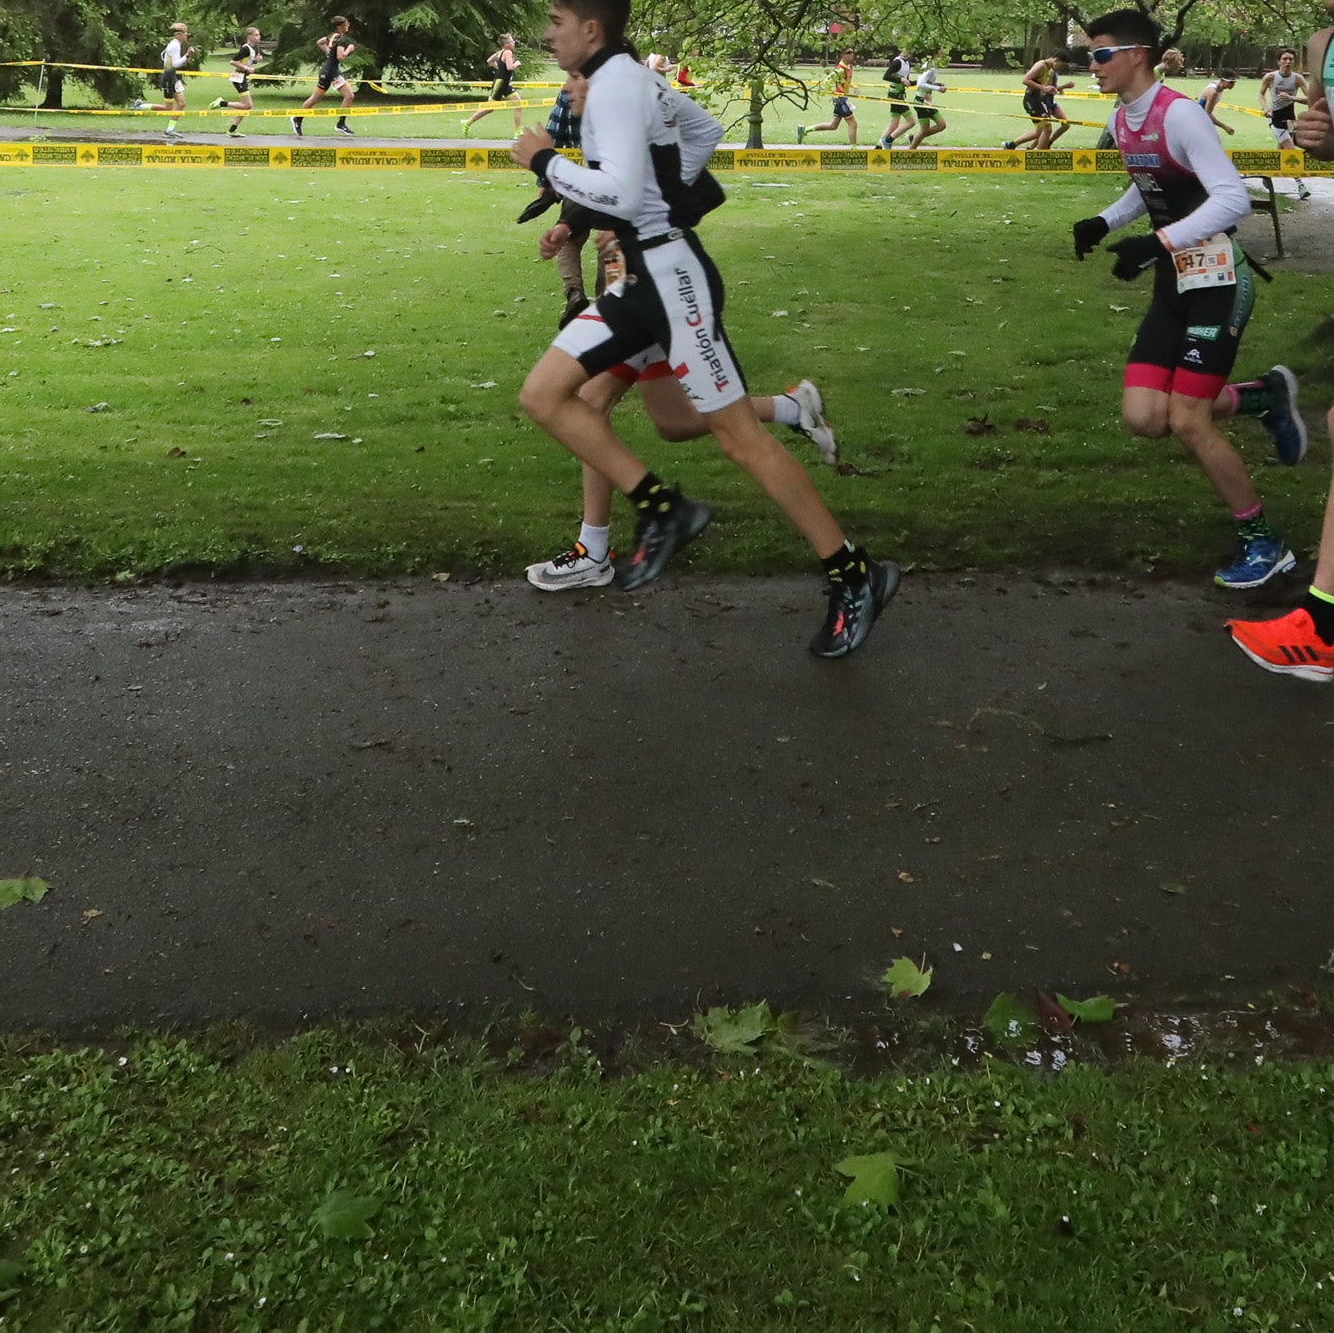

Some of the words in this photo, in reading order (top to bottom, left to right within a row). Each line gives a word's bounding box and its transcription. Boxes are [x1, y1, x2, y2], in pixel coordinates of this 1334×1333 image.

[941, 160, 973, 168] RURAL
[977, 160, 1002, 168] CAJA
[675, 268, 703, 327] Cuéllar
[695, 328, 730, 393] Triatlón
